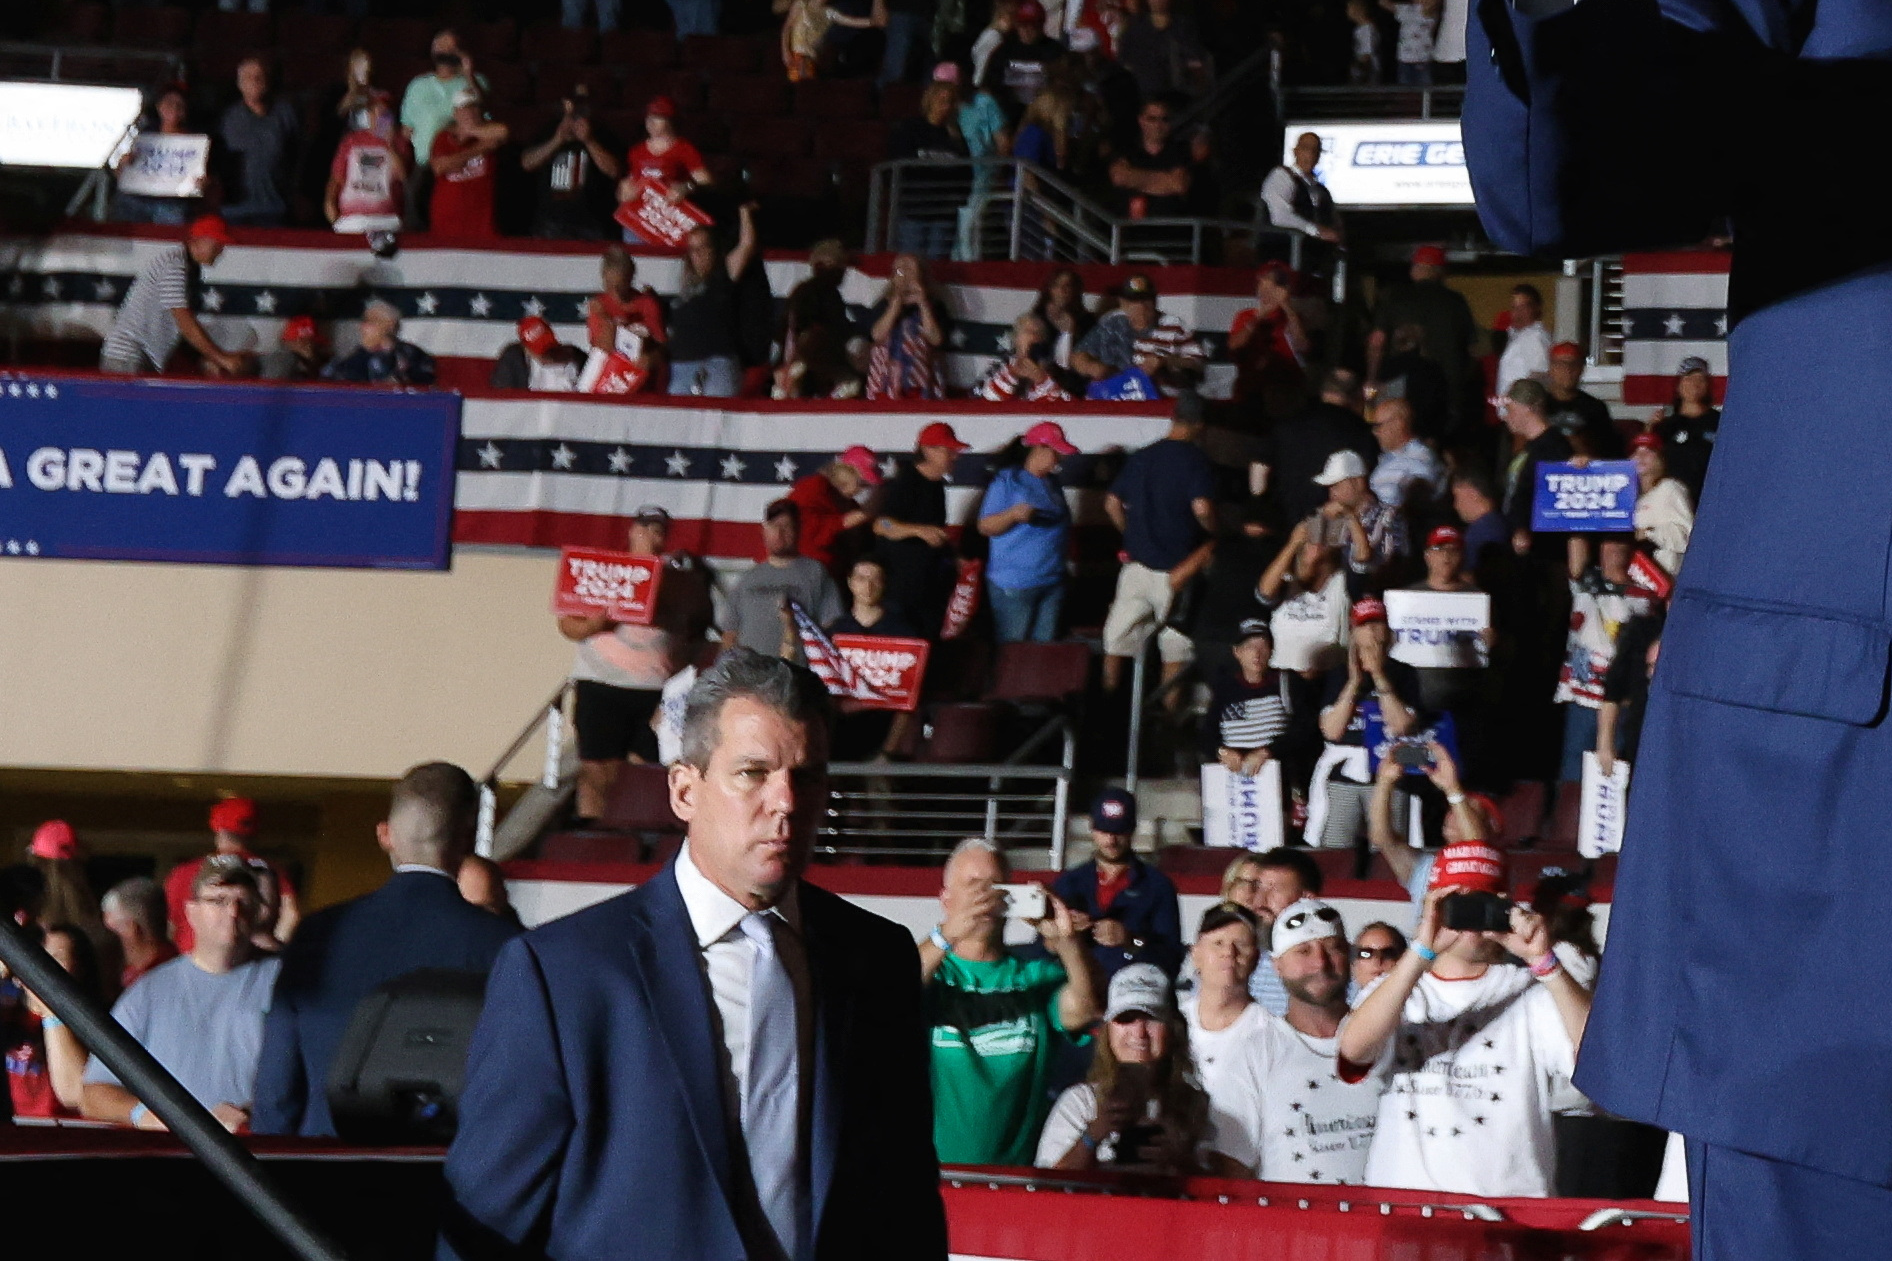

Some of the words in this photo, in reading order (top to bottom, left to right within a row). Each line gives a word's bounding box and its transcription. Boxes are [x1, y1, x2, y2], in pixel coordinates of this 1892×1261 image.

[1355, 143, 1422, 165] ERIE
[26, 446, 217, 497] GREAT
[224, 454, 422, 502] AGAIN!
[1545, 473, 1630, 493] TRUMP
[1553, 492, 1617, 509] 2024
[569, 557, 651, 584] TRUMP
